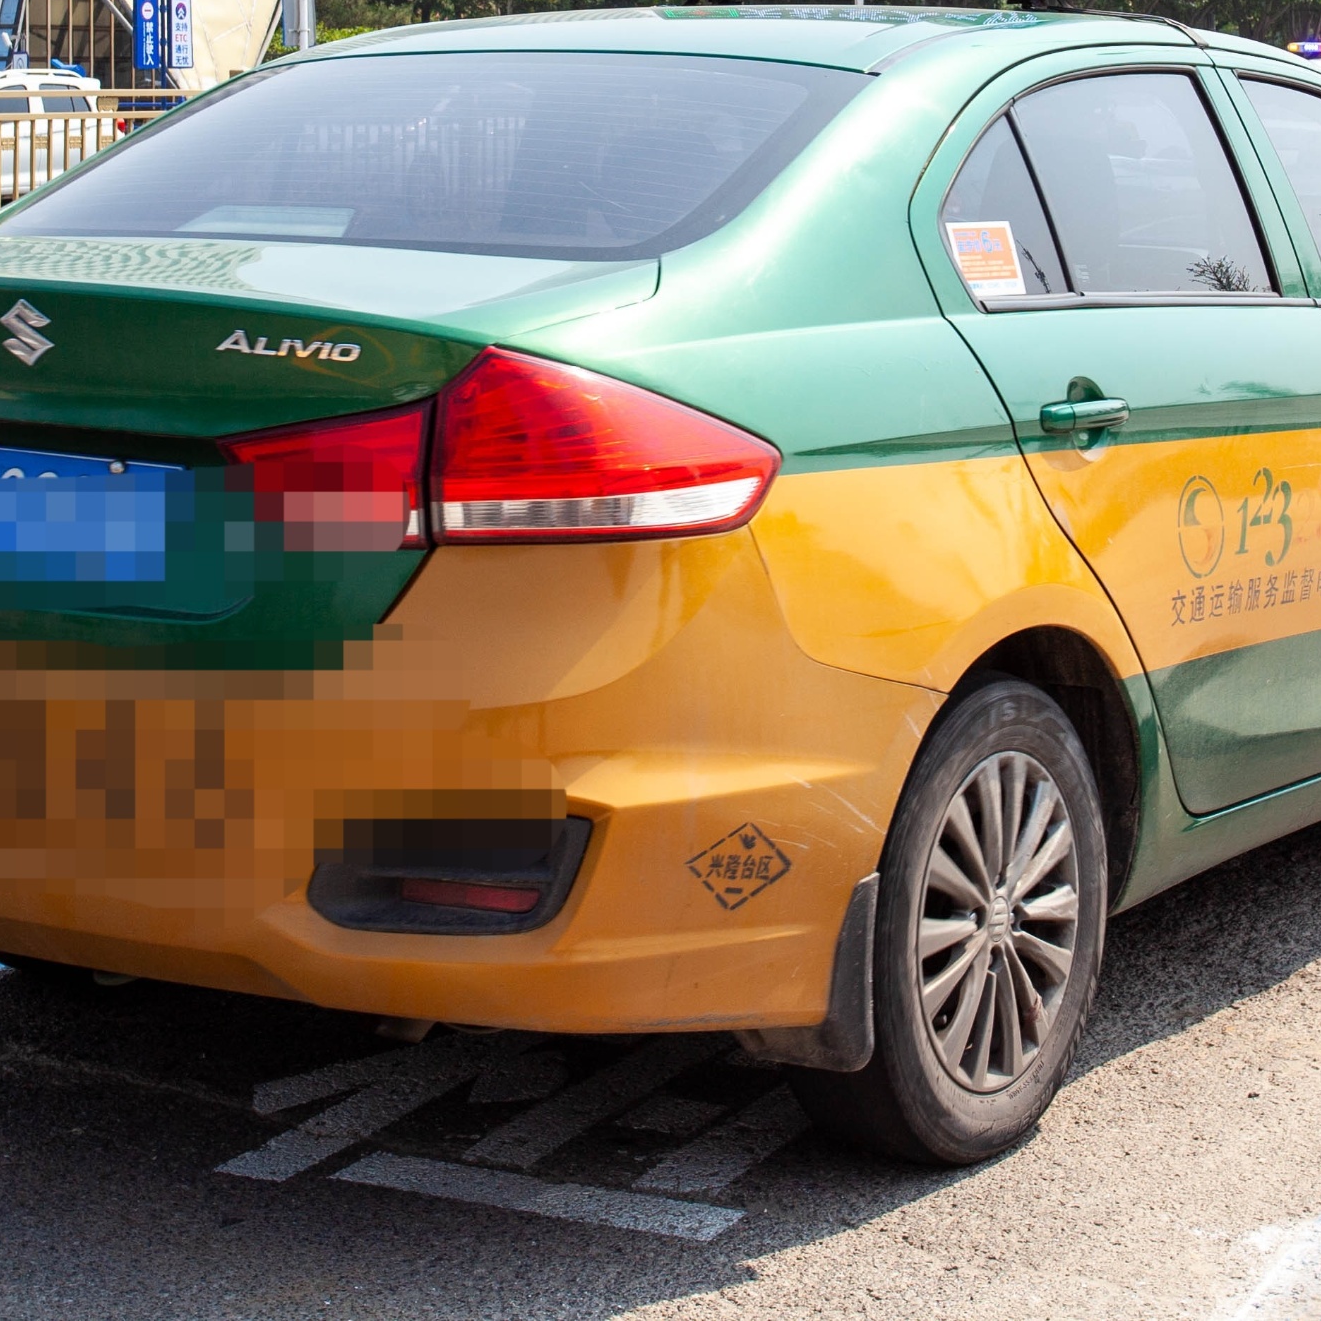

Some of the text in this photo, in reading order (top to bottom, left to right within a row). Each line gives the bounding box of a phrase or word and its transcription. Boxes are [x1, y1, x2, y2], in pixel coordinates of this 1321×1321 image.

[175, 23, 188, 32] 支持
[175, 34, 187, 43] ETC
[216, 330, 362, 363] ALIVIO
[705, 854, 773, 881] 兴隆台区
